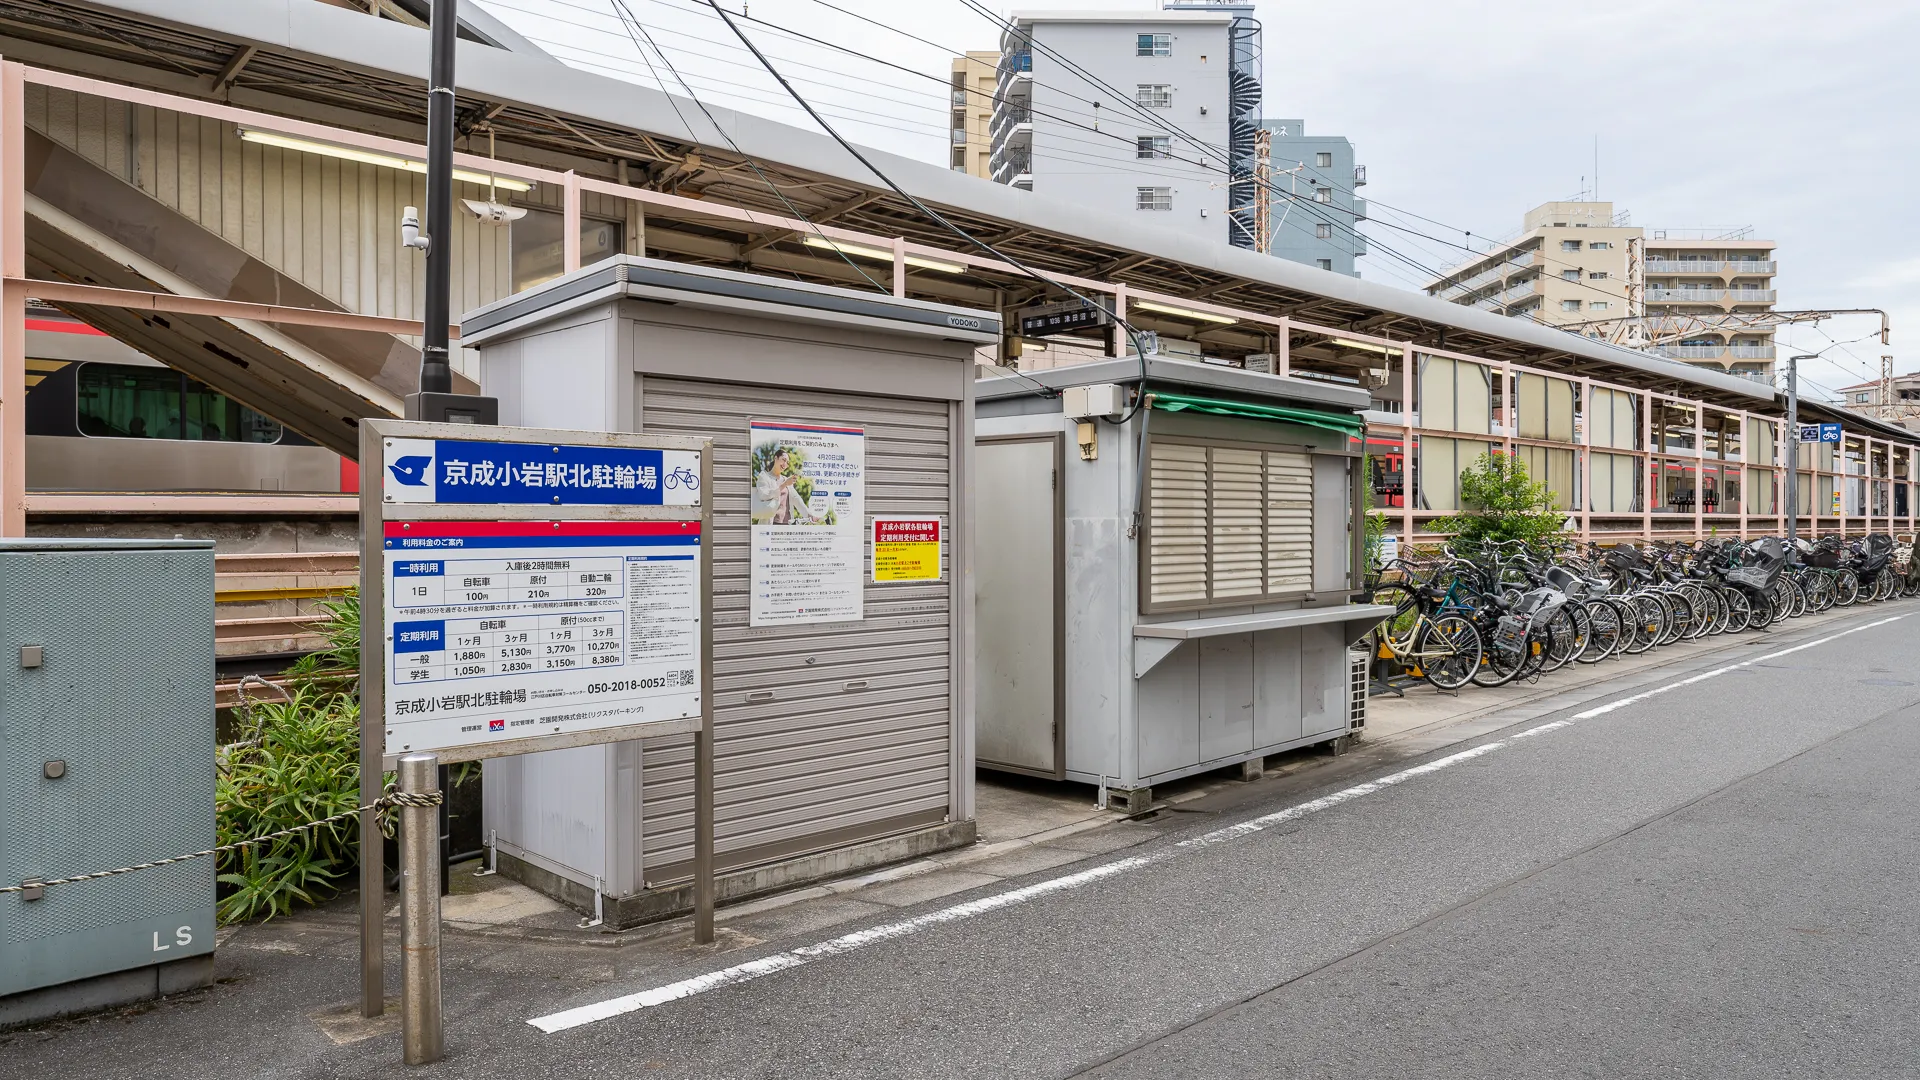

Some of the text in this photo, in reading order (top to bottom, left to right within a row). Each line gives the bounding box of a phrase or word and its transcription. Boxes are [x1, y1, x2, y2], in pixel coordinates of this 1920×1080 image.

[950, 317, 978, 328] YODOKO
[803, 461, 859, 470] 窓口にてお手続きください
[443, 459, 658, 490] 京成小岩駅北駐輪場
[402, 537, 464, 547] 利用料金のご案内
[400, 563, 439, 573] 一時利用
[505, 561, 570, 571] 入庫後2時間無料
[463, 577, 491, 587] 自転車
[530, 575, 547, 585] 原付
[580, 574, 612, 583] 自動二輪
[412, 586, 427, 596] 1日
[528, 590, 550, 599] 210円
[585, 587, 607, 596] 320円
[466, 592, 489, 601] 100円
[480, 620, 506, 630] 自転車
[560, 616, 605, 626] 原付(50ccまで)
[400, 630, 439, 642] 定期利用
[550, 630, 572, 640] 1ヶ月
[592, 627, 614, 637] 3ヶ月
[457, 636, 481, 646] 1ヶ月
[504, 633, 528, 643] 3ヶ月
[546, 645, 576, 654] 3,770円
[587, 642, 620, 651] 10,270円
[454, 652, 486, 661] 1,880円
[501, 648, 532, 658] 5,130円
[410, 655, 430, 665] 一般
[546, 659, 576, 668] 3,150円
[592, 654, 620, 664] 8,380円
[454, 666, 486, 676] 1,050円
[501, 662, 532, 672] 2,830円
[410, 670, 430, 680] 学生
[587, 677, 666, 694] 050-2018-0052
[394, 689, 527, 716] 京成小岩駅北駐輪場
[510, 719, 535, 727] 指定管理者
[461, 725, 482, 733] 管理運営
